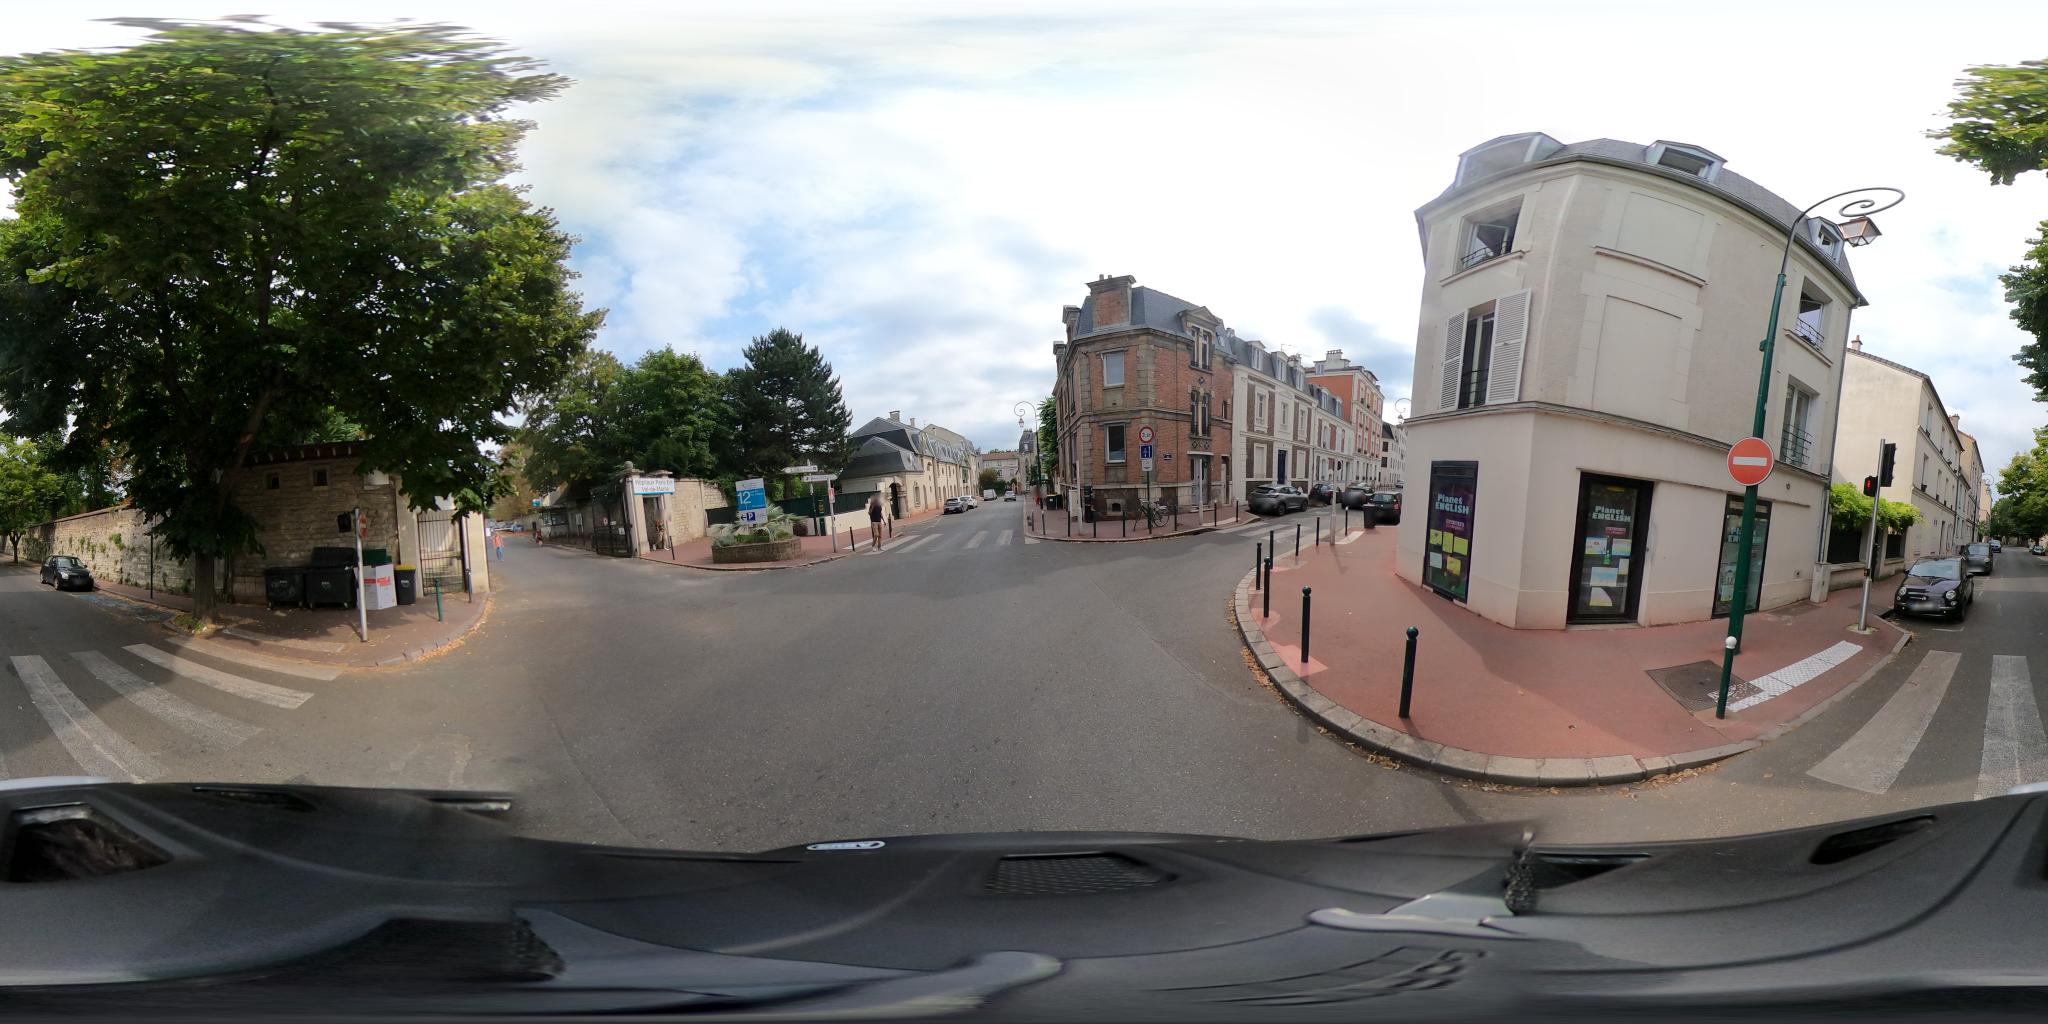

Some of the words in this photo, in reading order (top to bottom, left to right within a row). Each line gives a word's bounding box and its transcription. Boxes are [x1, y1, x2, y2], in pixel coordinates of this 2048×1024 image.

[737, 491, 752, 504] 12
[1437, 493, 1463, 504] Planet
[1435, 501, 1469, 515] ENGLISH
[1595, 505, 1625, 515] Planet
[1592, 512, 1632, 523] ENGLISH
